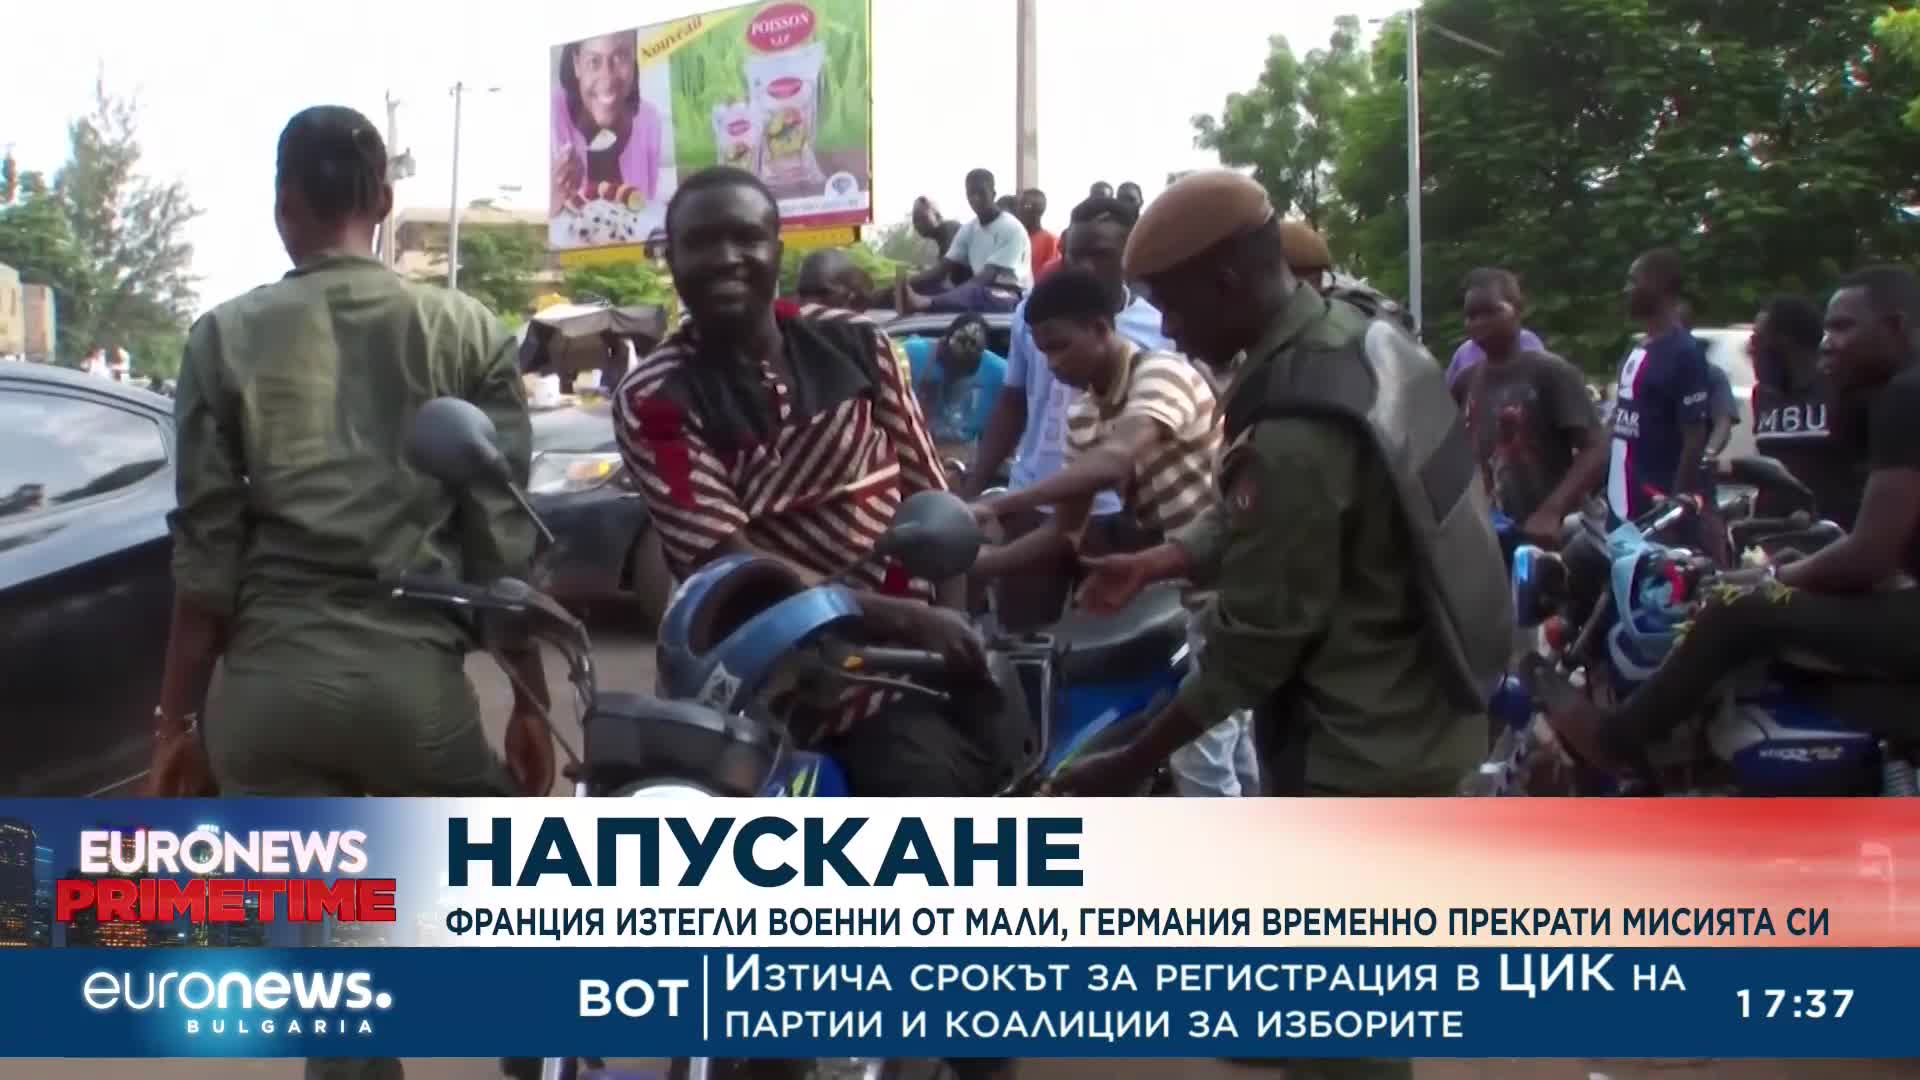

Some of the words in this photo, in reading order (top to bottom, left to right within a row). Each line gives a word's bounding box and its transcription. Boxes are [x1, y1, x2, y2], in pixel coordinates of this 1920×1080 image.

[640, 15, 704, 57] Nouveau
[750, 12, 809, 37] POISSON
[1758, 403, 1826, 432] MBU
